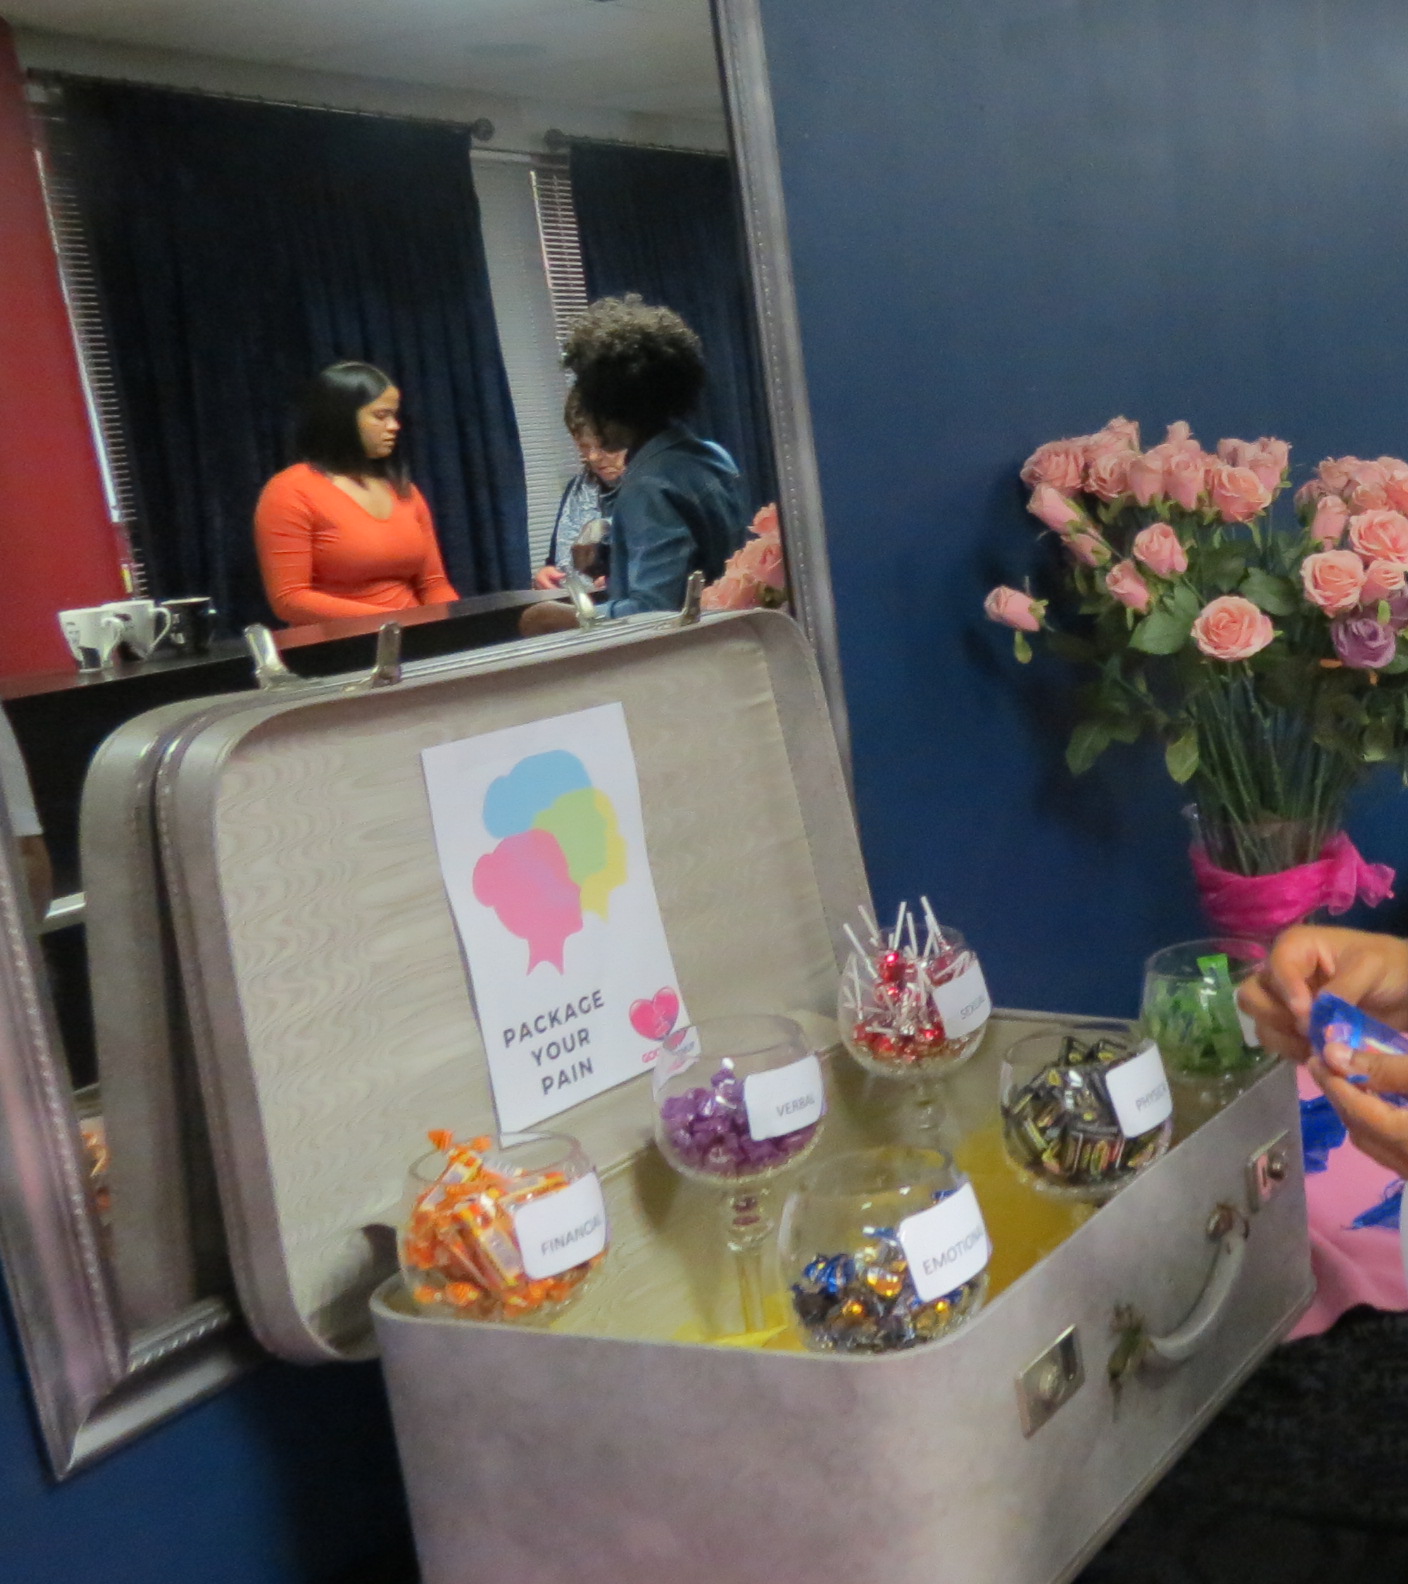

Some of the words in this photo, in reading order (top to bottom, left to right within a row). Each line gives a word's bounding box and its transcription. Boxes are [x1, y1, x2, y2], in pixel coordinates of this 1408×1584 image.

[502, 988, 605, 1049] PACKAGE
[531, 1028, 591, 1067] YOUR
[541, 1057, 594, 1096] PAIN
[775, 1093, 816, 1117] VERBAL
